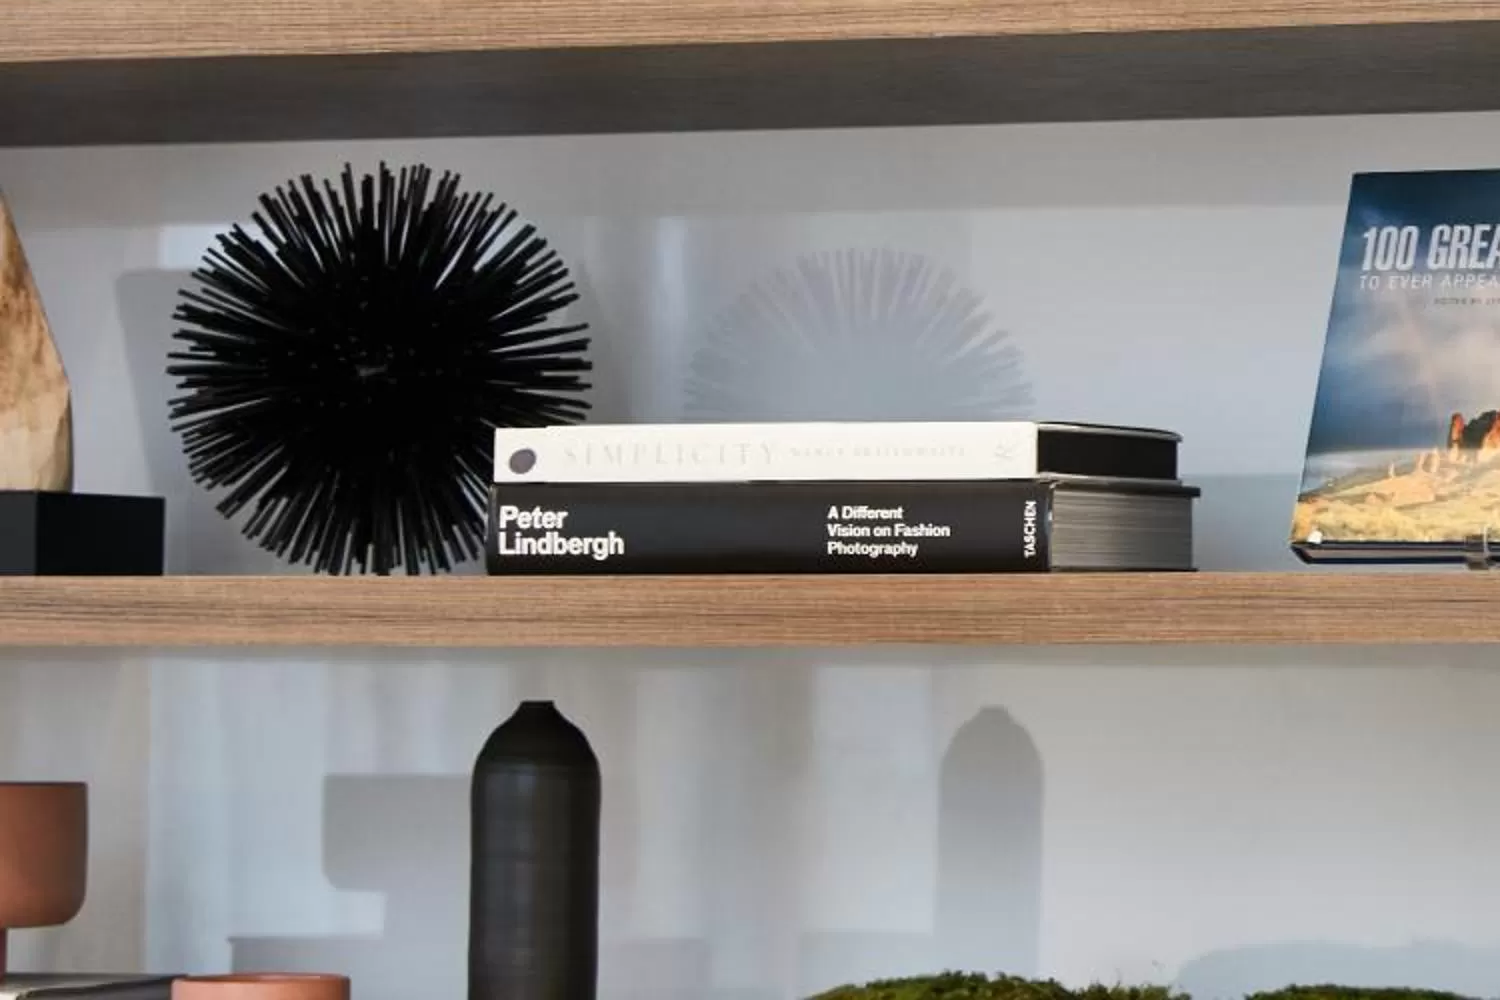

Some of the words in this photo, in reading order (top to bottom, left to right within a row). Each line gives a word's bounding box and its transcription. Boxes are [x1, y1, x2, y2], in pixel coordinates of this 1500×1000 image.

[1362, 225, 1420, 272] 100
[1359, 275, 1380, 290] TO
[1388, 274, 1432, 289] EVER
[563, 441, 774, 467] SIMPLICITY
[499, 505, 569, 529] Peter
[827, 506, 839, 519] A
[841, 505, 904, 520] Different
[827, 524, 871, 538] Vision
[873, 527, 891, 538] on
[894, 523, 951, 538] Fashion
[1024, 500, 1037, 559] TASCHEN
[498, 530, 625, 561] Lindbergh
[827, 541, 919, 558] Photography
